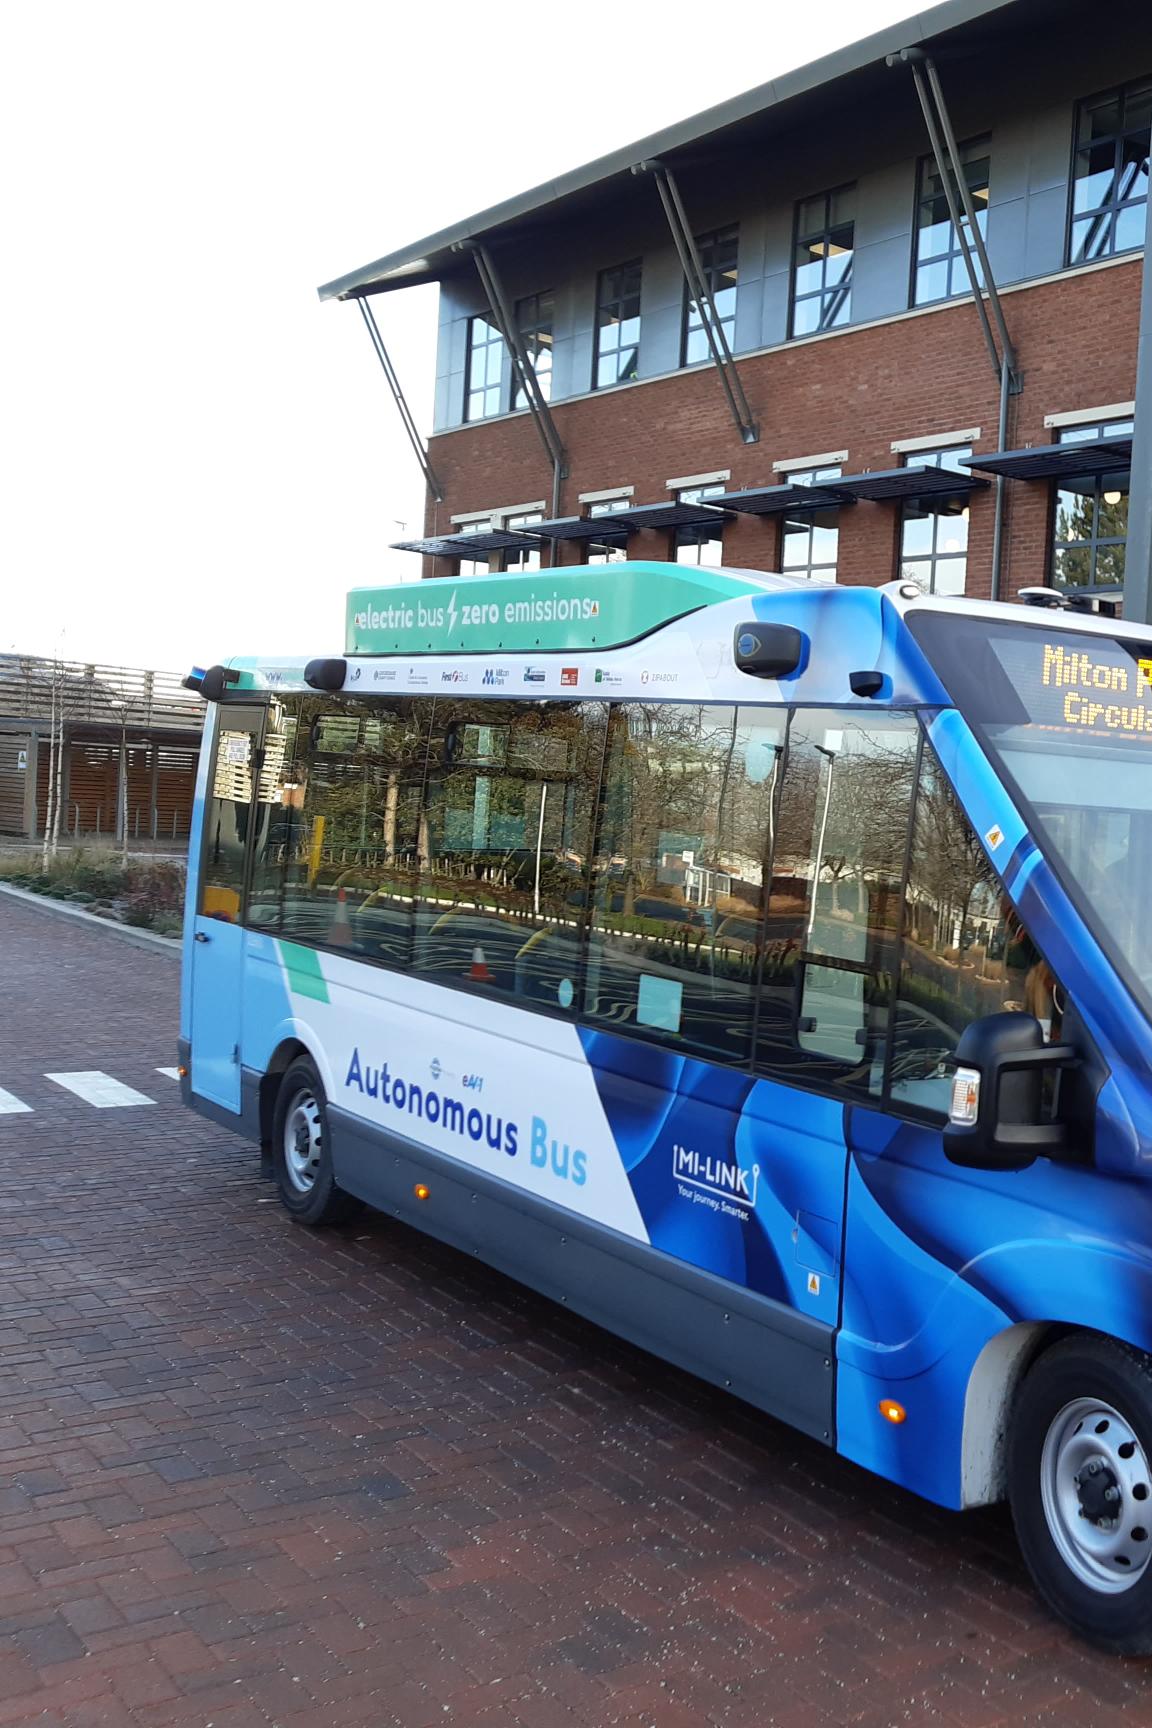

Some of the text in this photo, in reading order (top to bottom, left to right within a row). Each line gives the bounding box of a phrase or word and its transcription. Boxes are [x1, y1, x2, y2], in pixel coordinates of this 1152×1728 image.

[359, 592, 591, 629] electric bus zero emissions
[1042, 644, 1128, 692] Milton
[345, 1047, 587, 1186] Autonomous Bus
[677, 1183, 693, 1198] Your
[678, 1147, 749, 1195] MI-LINK
